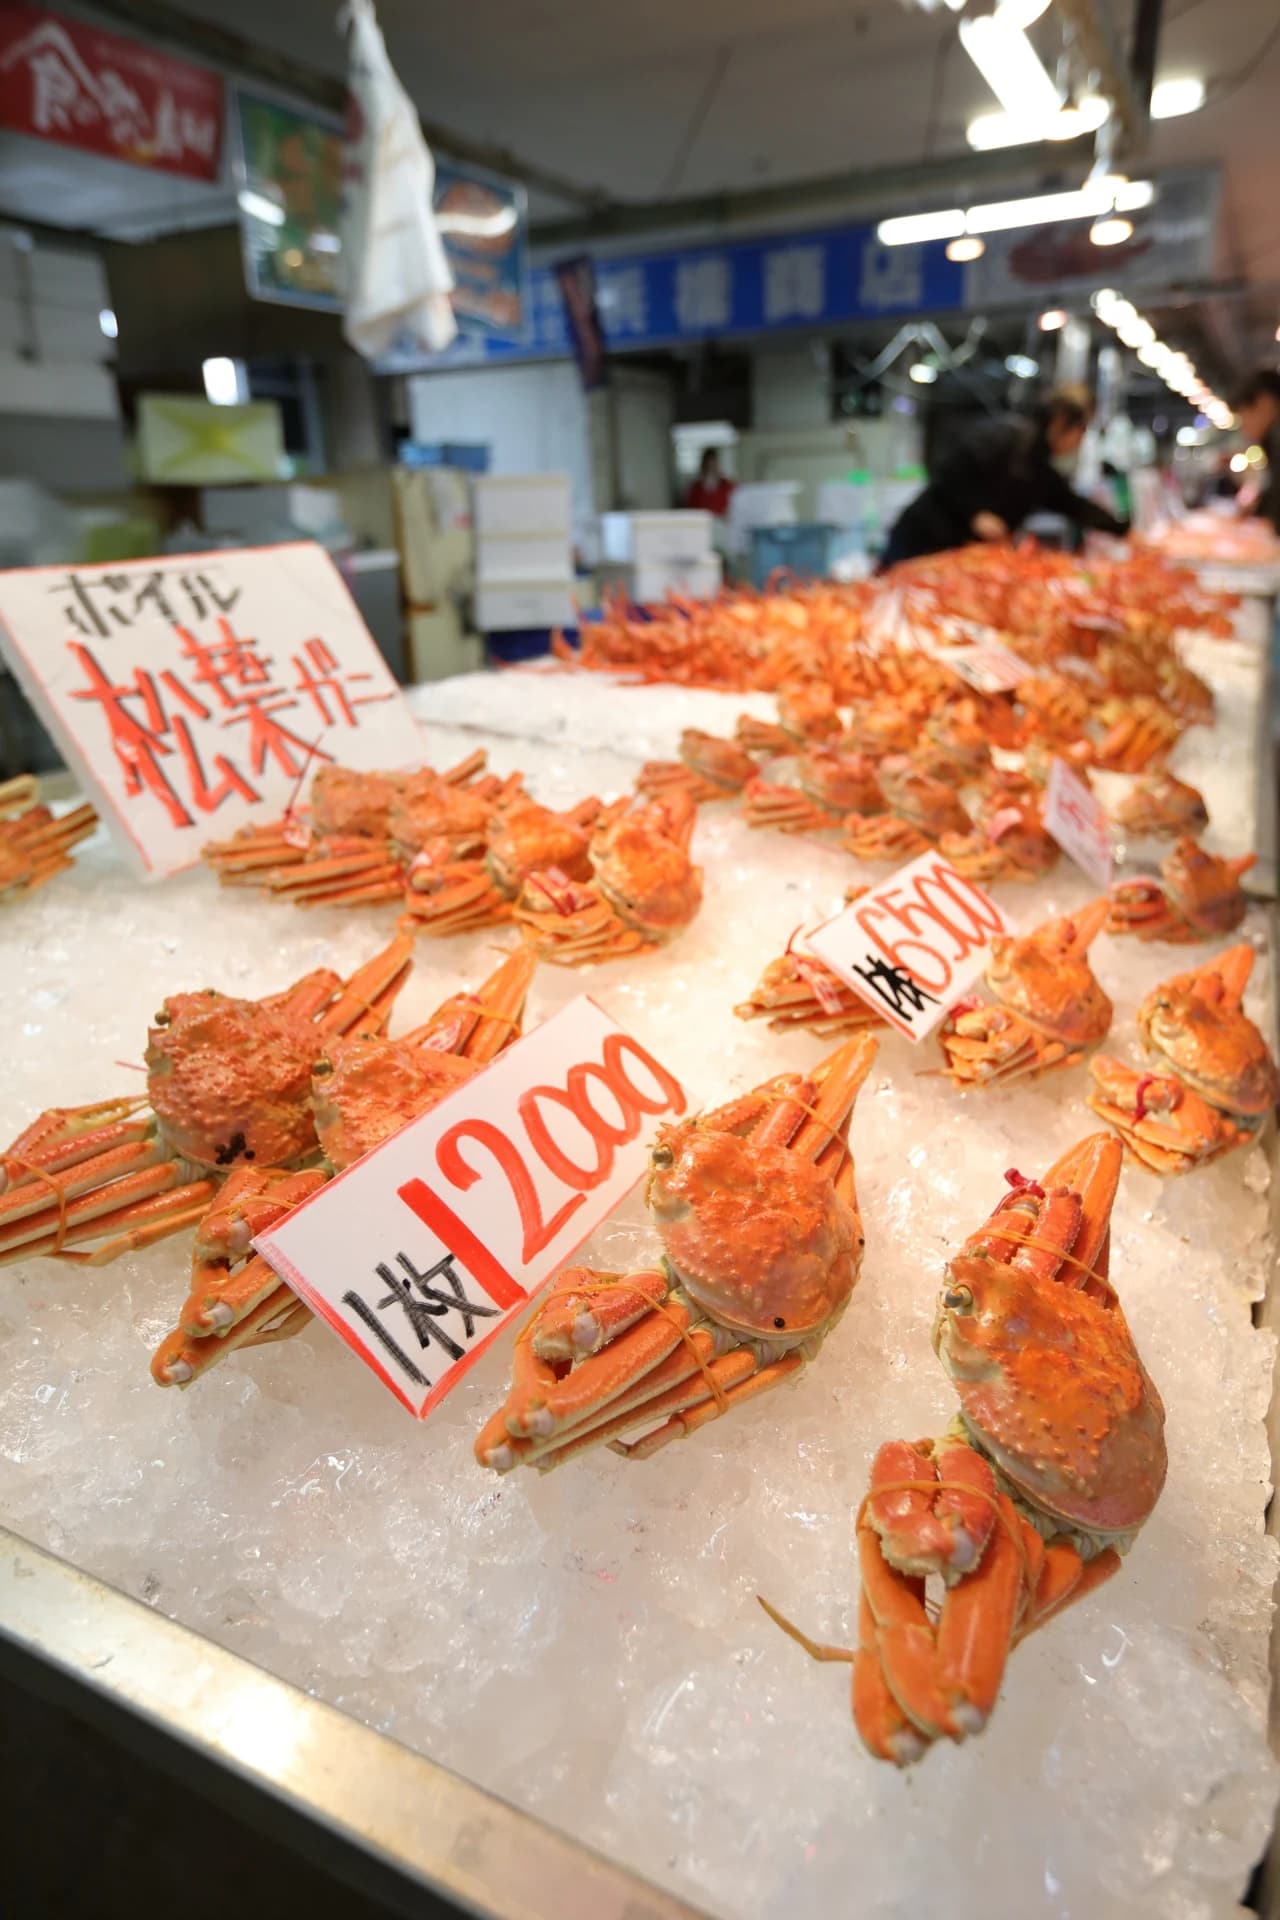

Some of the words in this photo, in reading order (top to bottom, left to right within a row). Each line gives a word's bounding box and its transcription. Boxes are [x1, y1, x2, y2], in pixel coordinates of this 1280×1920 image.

[49, 572, 240, 636] ボイル
[66, 617, 394, 828] 松葉ガニ
[855, 864, 1005, 993] 6500
[397, 1033, 687, 1310] 12000
[341, 1251, 503, 1387] 1枚
